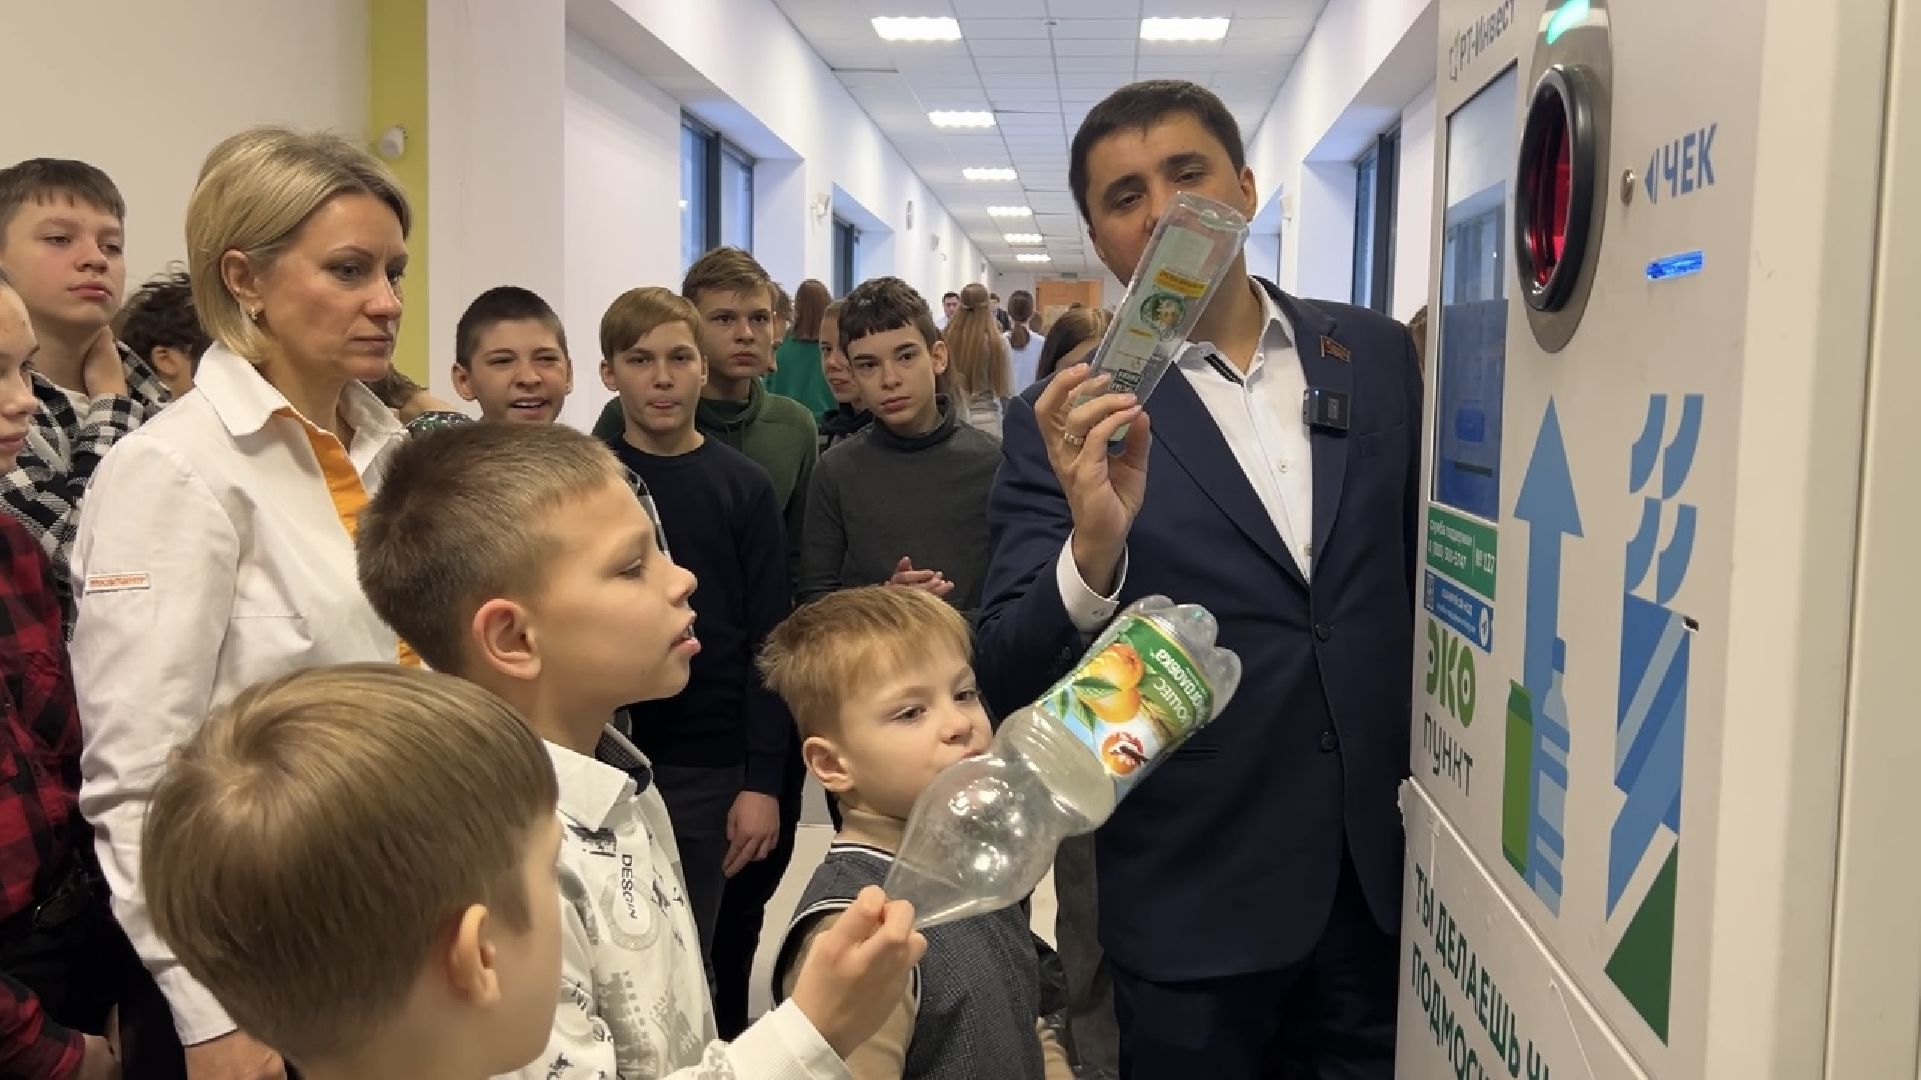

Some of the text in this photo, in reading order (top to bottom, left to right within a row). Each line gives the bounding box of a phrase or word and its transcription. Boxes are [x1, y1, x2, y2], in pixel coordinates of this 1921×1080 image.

[1663, 123, 1717, 199] ЧЕК
[1416, 863, 1434, 936] ТЫ
[1436, 901, 1520, 1078] ДЕЛАЕШЬ
